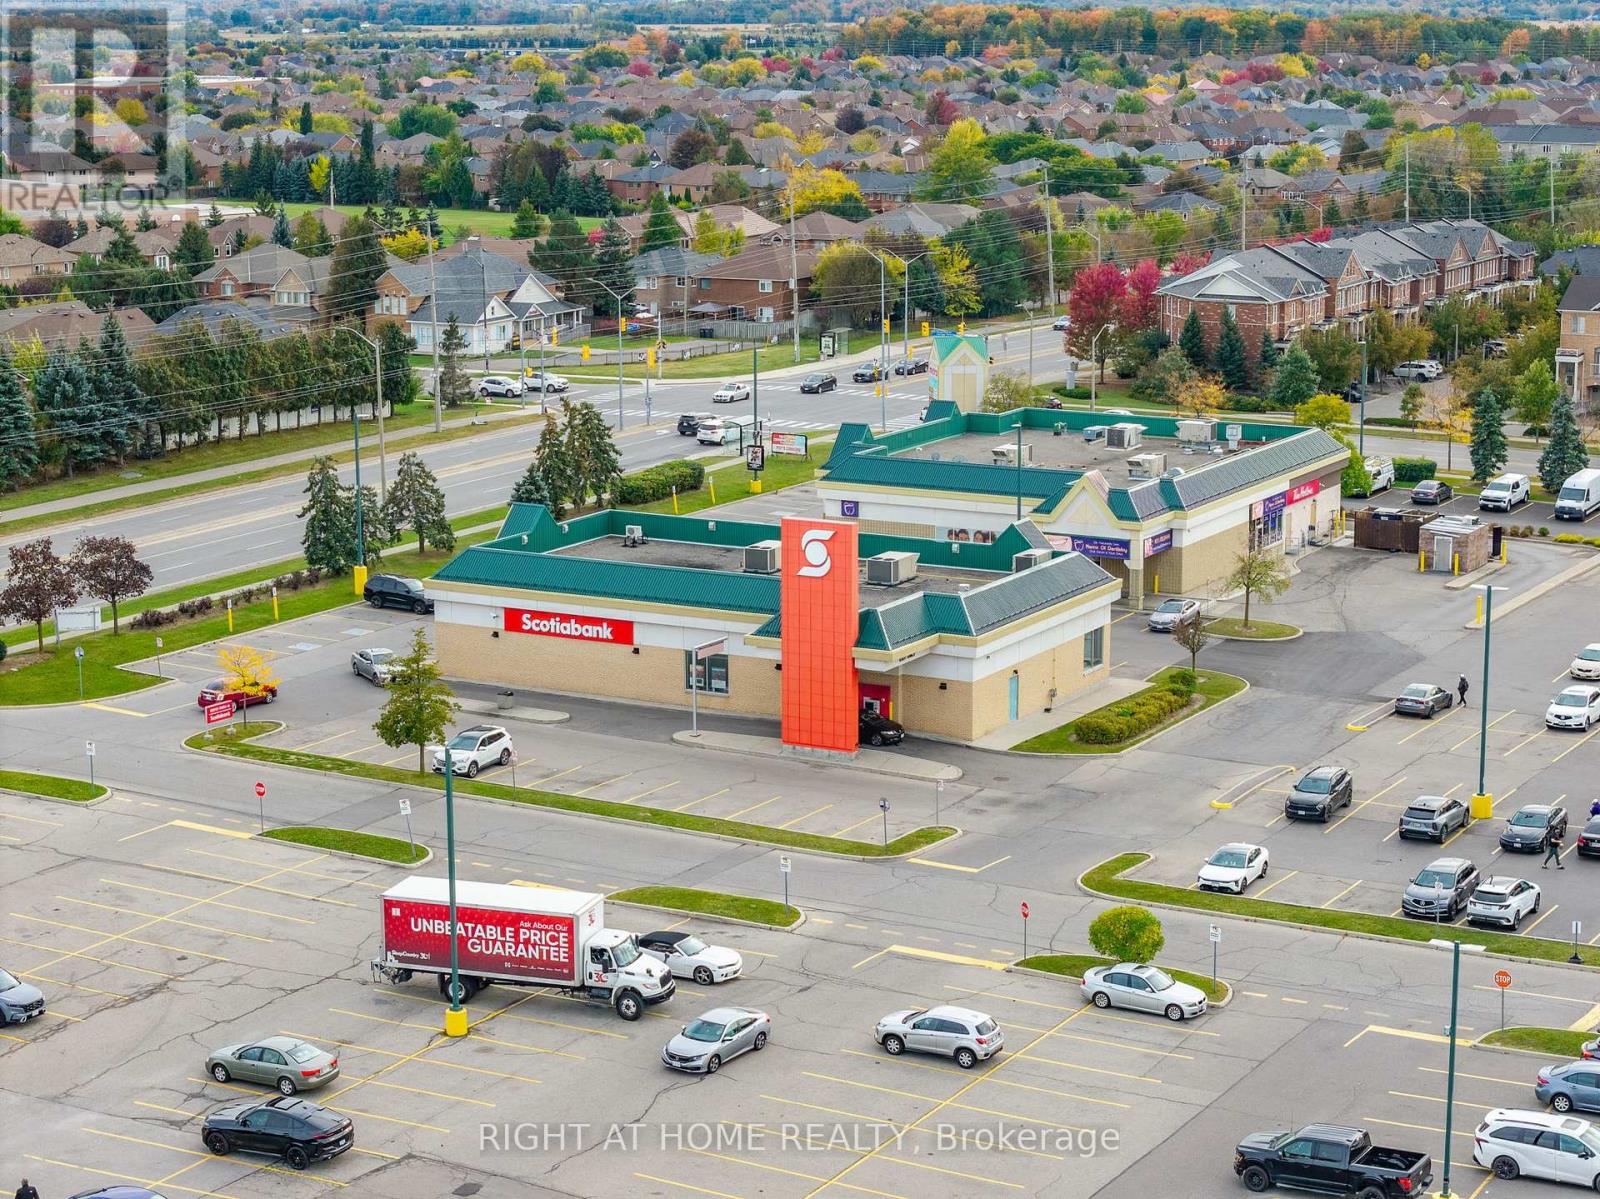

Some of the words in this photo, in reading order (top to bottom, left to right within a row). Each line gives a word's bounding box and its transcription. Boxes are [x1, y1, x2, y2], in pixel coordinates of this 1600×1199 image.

[521, 613, 614, 639] Scotiabank
[410, 917, 515, 942] UNBEATABLE
[519, 928, 569, 947] PRICE
[519, 920, 531, 928] Ask
[532, 922, 554, 930] About
[467, 938, 569, 962] GUARANTEE
[1495, 975, 1511, 983] STOP
